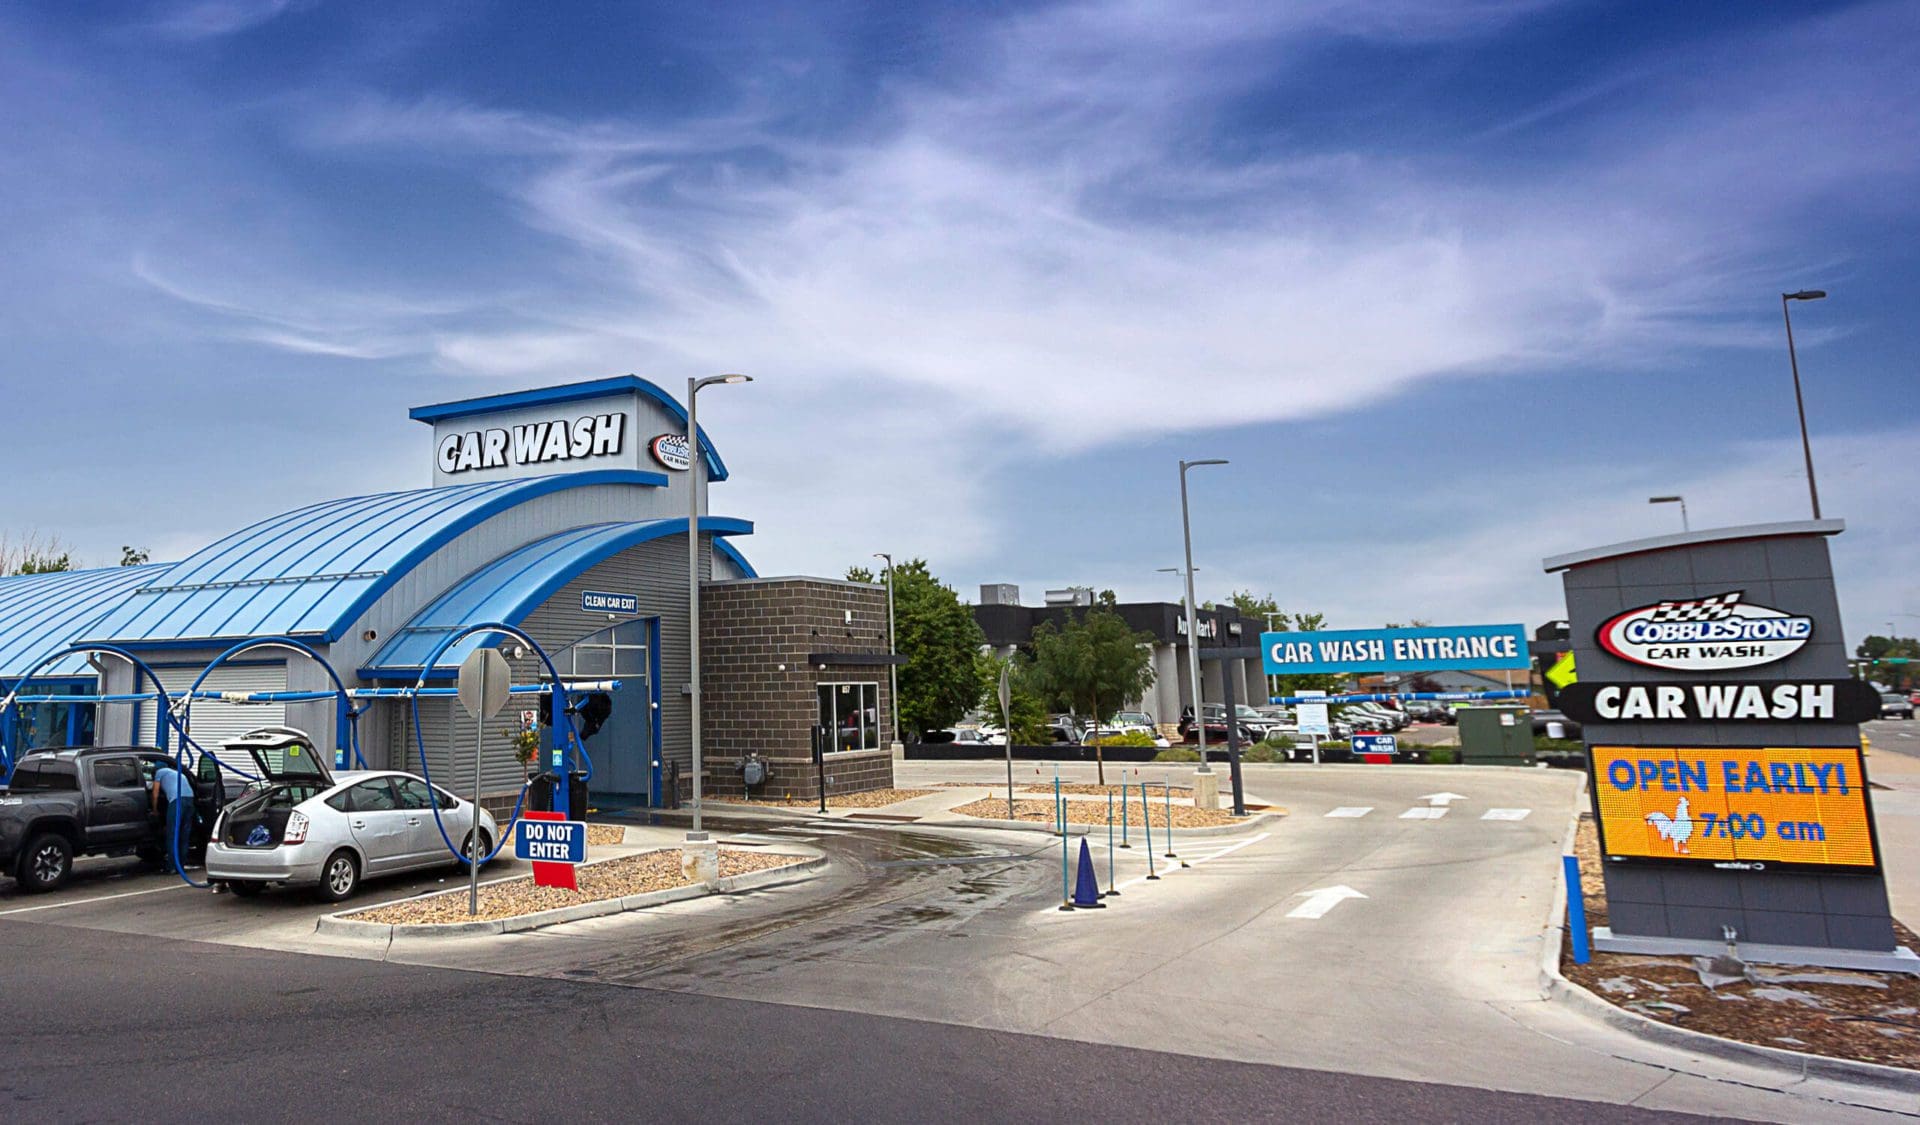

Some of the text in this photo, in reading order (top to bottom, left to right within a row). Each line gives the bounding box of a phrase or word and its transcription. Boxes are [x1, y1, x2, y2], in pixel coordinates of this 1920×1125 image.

[438, 413, 625, 474] CAR WASH
[585, 595, 635, 609] CLEAN CAR EXIT
[1626, 616, 1811, 643] COBBLESTONE
[1271, 635, 1518, 663] CAR WASH ENTRANCE
[1647, 645, 1765, 659] CAR WASH
[1594, 684, 1835, 719] CAR WASH
[1368, 744, 1394, 753] WASH
[1375, 736, 1393, 745] CAR
[1607, 759, 1849, 796] OPEN EARLY!
[525, 823, 573, 841] DO NOT
[1699, 813, 1826, 841] 7:00 am
[529, 841, 570, 859] ENTER
